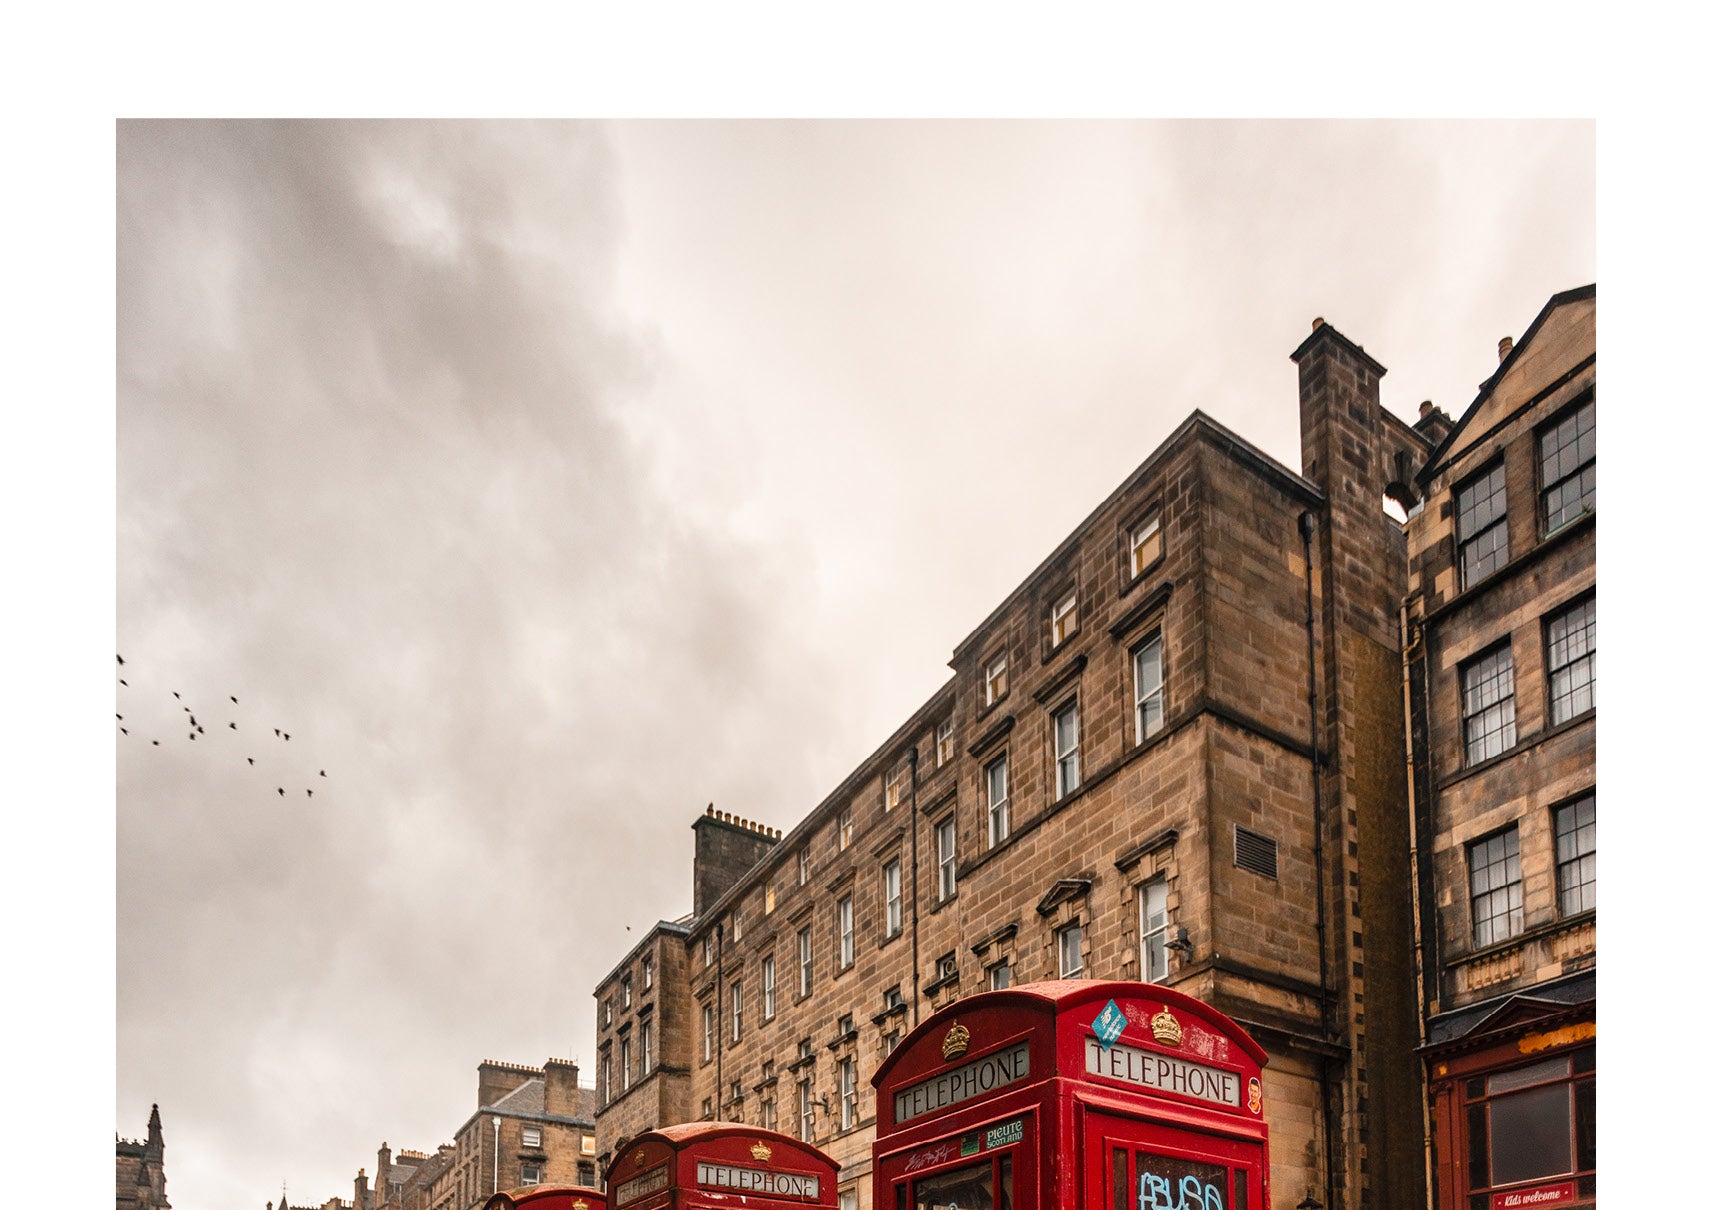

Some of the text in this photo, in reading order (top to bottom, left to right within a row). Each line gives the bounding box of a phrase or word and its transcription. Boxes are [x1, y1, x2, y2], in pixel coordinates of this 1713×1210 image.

[899, 1048, 1027, 1120] TELEPHONE
[1091, 1043, 1233, 1103] TELEPHONE
[987, 1131, 1023, 1149] SCOTLAND
[701, 1165, 813, 1197] TELEPHONE
[1522, 1190, 1560, 1203] welcome
